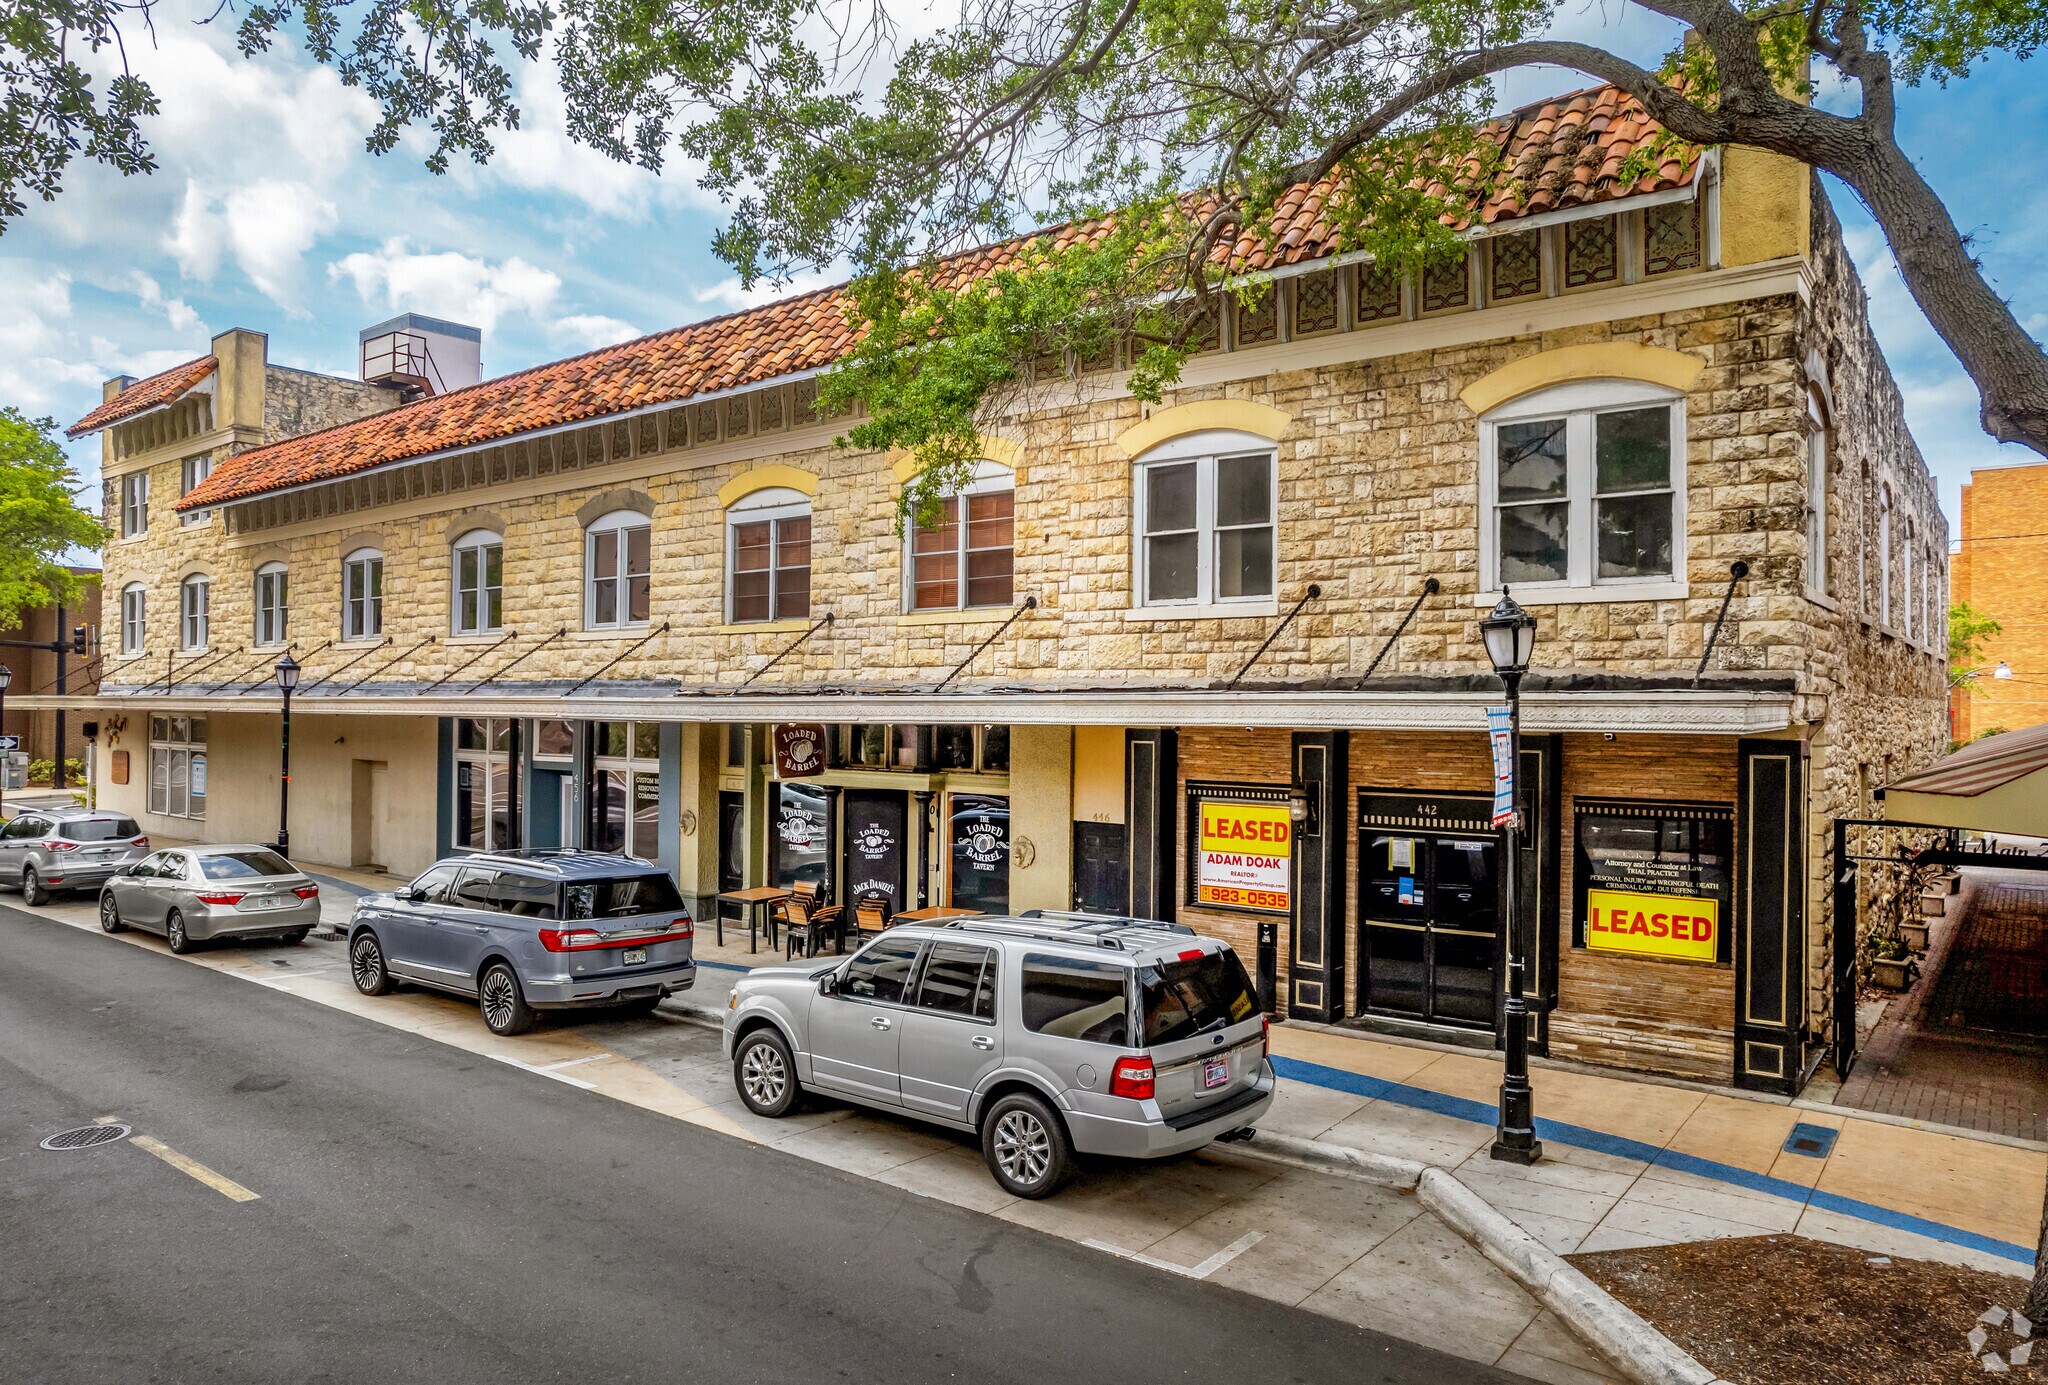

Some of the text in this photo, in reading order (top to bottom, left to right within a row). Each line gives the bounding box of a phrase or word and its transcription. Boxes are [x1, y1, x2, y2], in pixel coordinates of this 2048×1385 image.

[783, 729, 817, 743] LOADED
[785, 756, 820, 771] BARREL
[784, 810, 812, 821] LOADED
[1418, 804, 1437, 815] 442
[859, 829, 890, 837] LOADED
[966, 824, 1003, 837] LOADED
[1204, 818, 1288, 842] LEASED
[784, 830, 812, 844] BARREL
[859, 844, 889, 853] BARREL
[1974, 838, 2028, 856] Main
[966, 846, 1002, 862] BARREL
[973, 862, 995, 871] TAVERN
[1207, 853, 1281, 869] ADAM DOAK
[1604, 859, 1632, 869] Attorney
[1646, 862, 1679, 871] Counselor
[1688, 864, 1703, 872] Law
[853, 882, 869, 894] JACK
[1203, 877, 1286, 888] www.AmericanPropertyGroup.com
[1606, 882, 1637, 890] CRIMINAL
[1671, 886, 1699, 894] DEFENSE
[1657, 880, 1695, 888] WRONGFUL
[1211, 888, 1287, 907] 923-0535
[1592, 908, 1712, 941] LEASED
